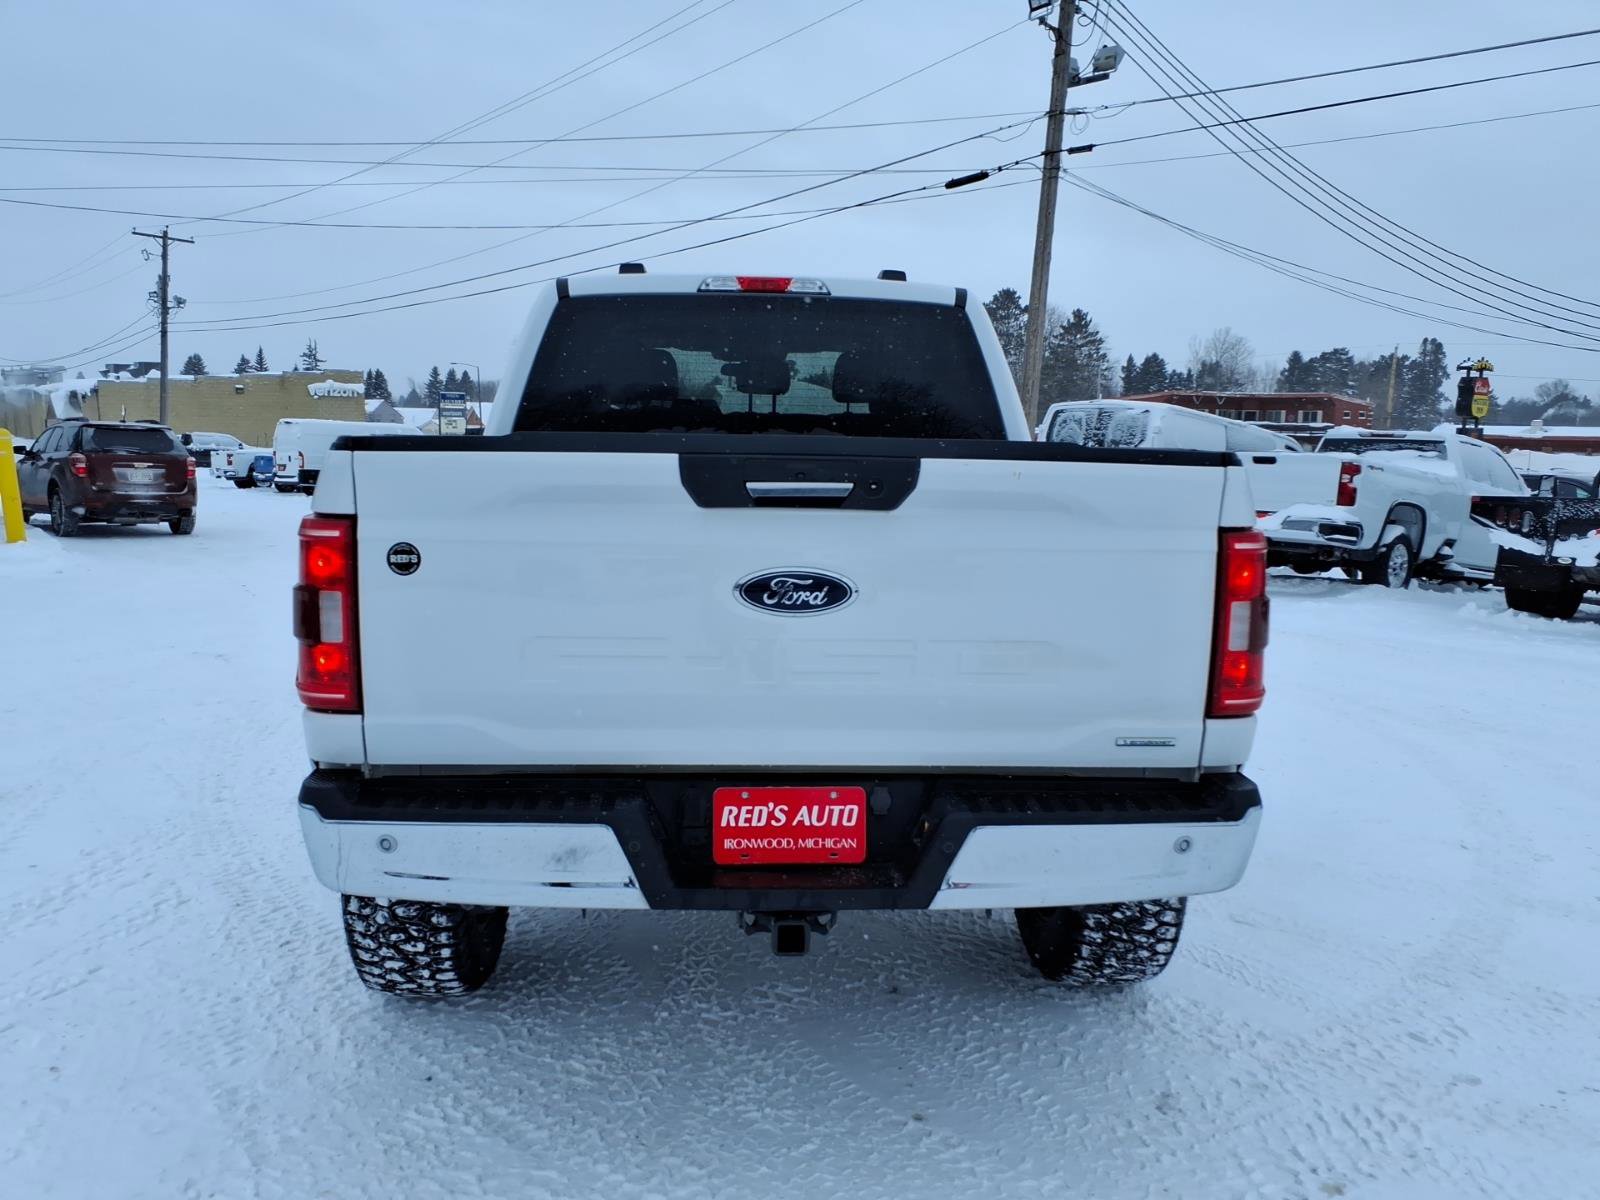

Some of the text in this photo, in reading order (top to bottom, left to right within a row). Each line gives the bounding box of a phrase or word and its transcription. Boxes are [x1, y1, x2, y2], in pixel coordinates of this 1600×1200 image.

[307, 383, 358, 397] verizon
[762, 577, 829, 605] Ford
[720, 802, 859, 827] RED'S AUTO
[723, 837, 857, 850] IRONWOOD, MICHIGAN
